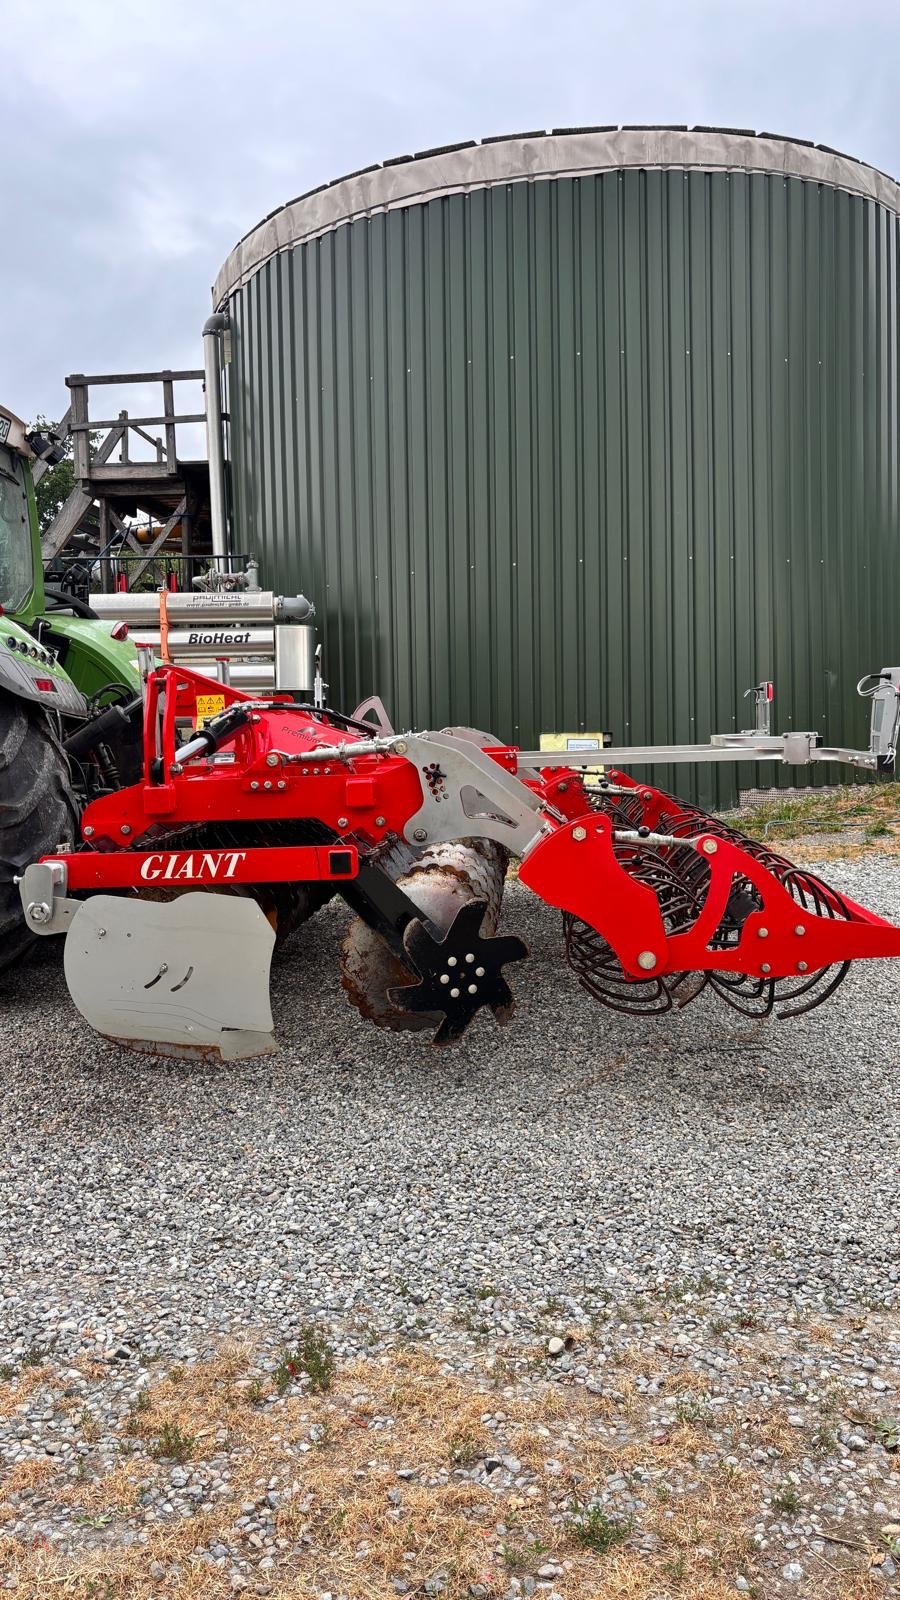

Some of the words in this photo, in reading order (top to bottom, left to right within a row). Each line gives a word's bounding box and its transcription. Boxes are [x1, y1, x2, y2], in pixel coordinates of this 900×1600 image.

[188, 632, 251, 644] BioHeat
[280, 726, 321, 743] Premium
[140, 852, 246, 880] GIANT
